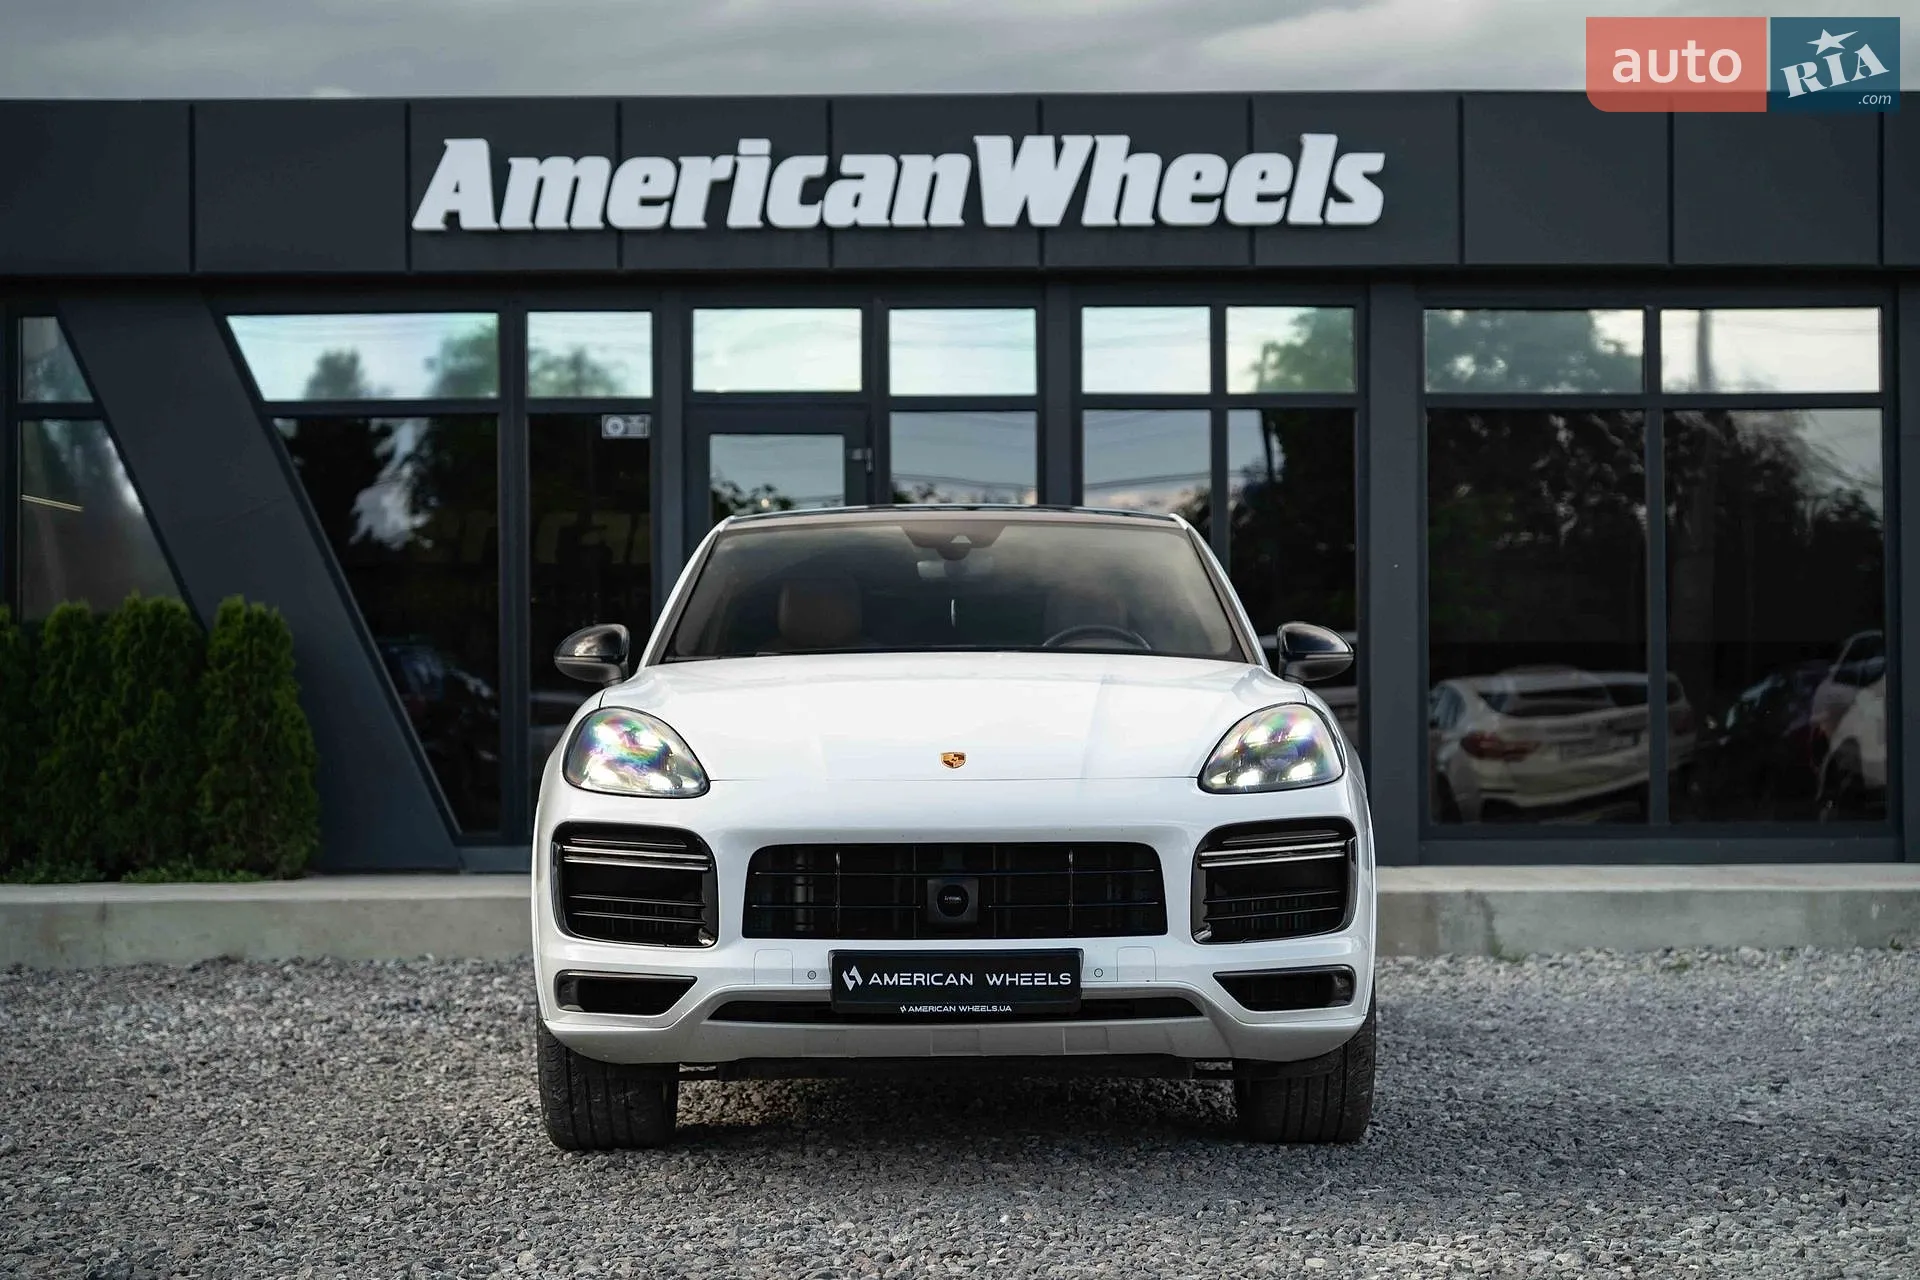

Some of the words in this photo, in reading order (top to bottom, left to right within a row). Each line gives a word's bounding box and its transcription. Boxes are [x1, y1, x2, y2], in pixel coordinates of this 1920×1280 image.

[411, 133, 1386, 231] AmericanWheels
[868, 972, 974, 986] AMERICAN
[985, 972, 1072, 986] WHEELS
[907, 1005, 957, 1013] AMERICAN
[958, 1005, 1013, 1013] WHEELS.UA
